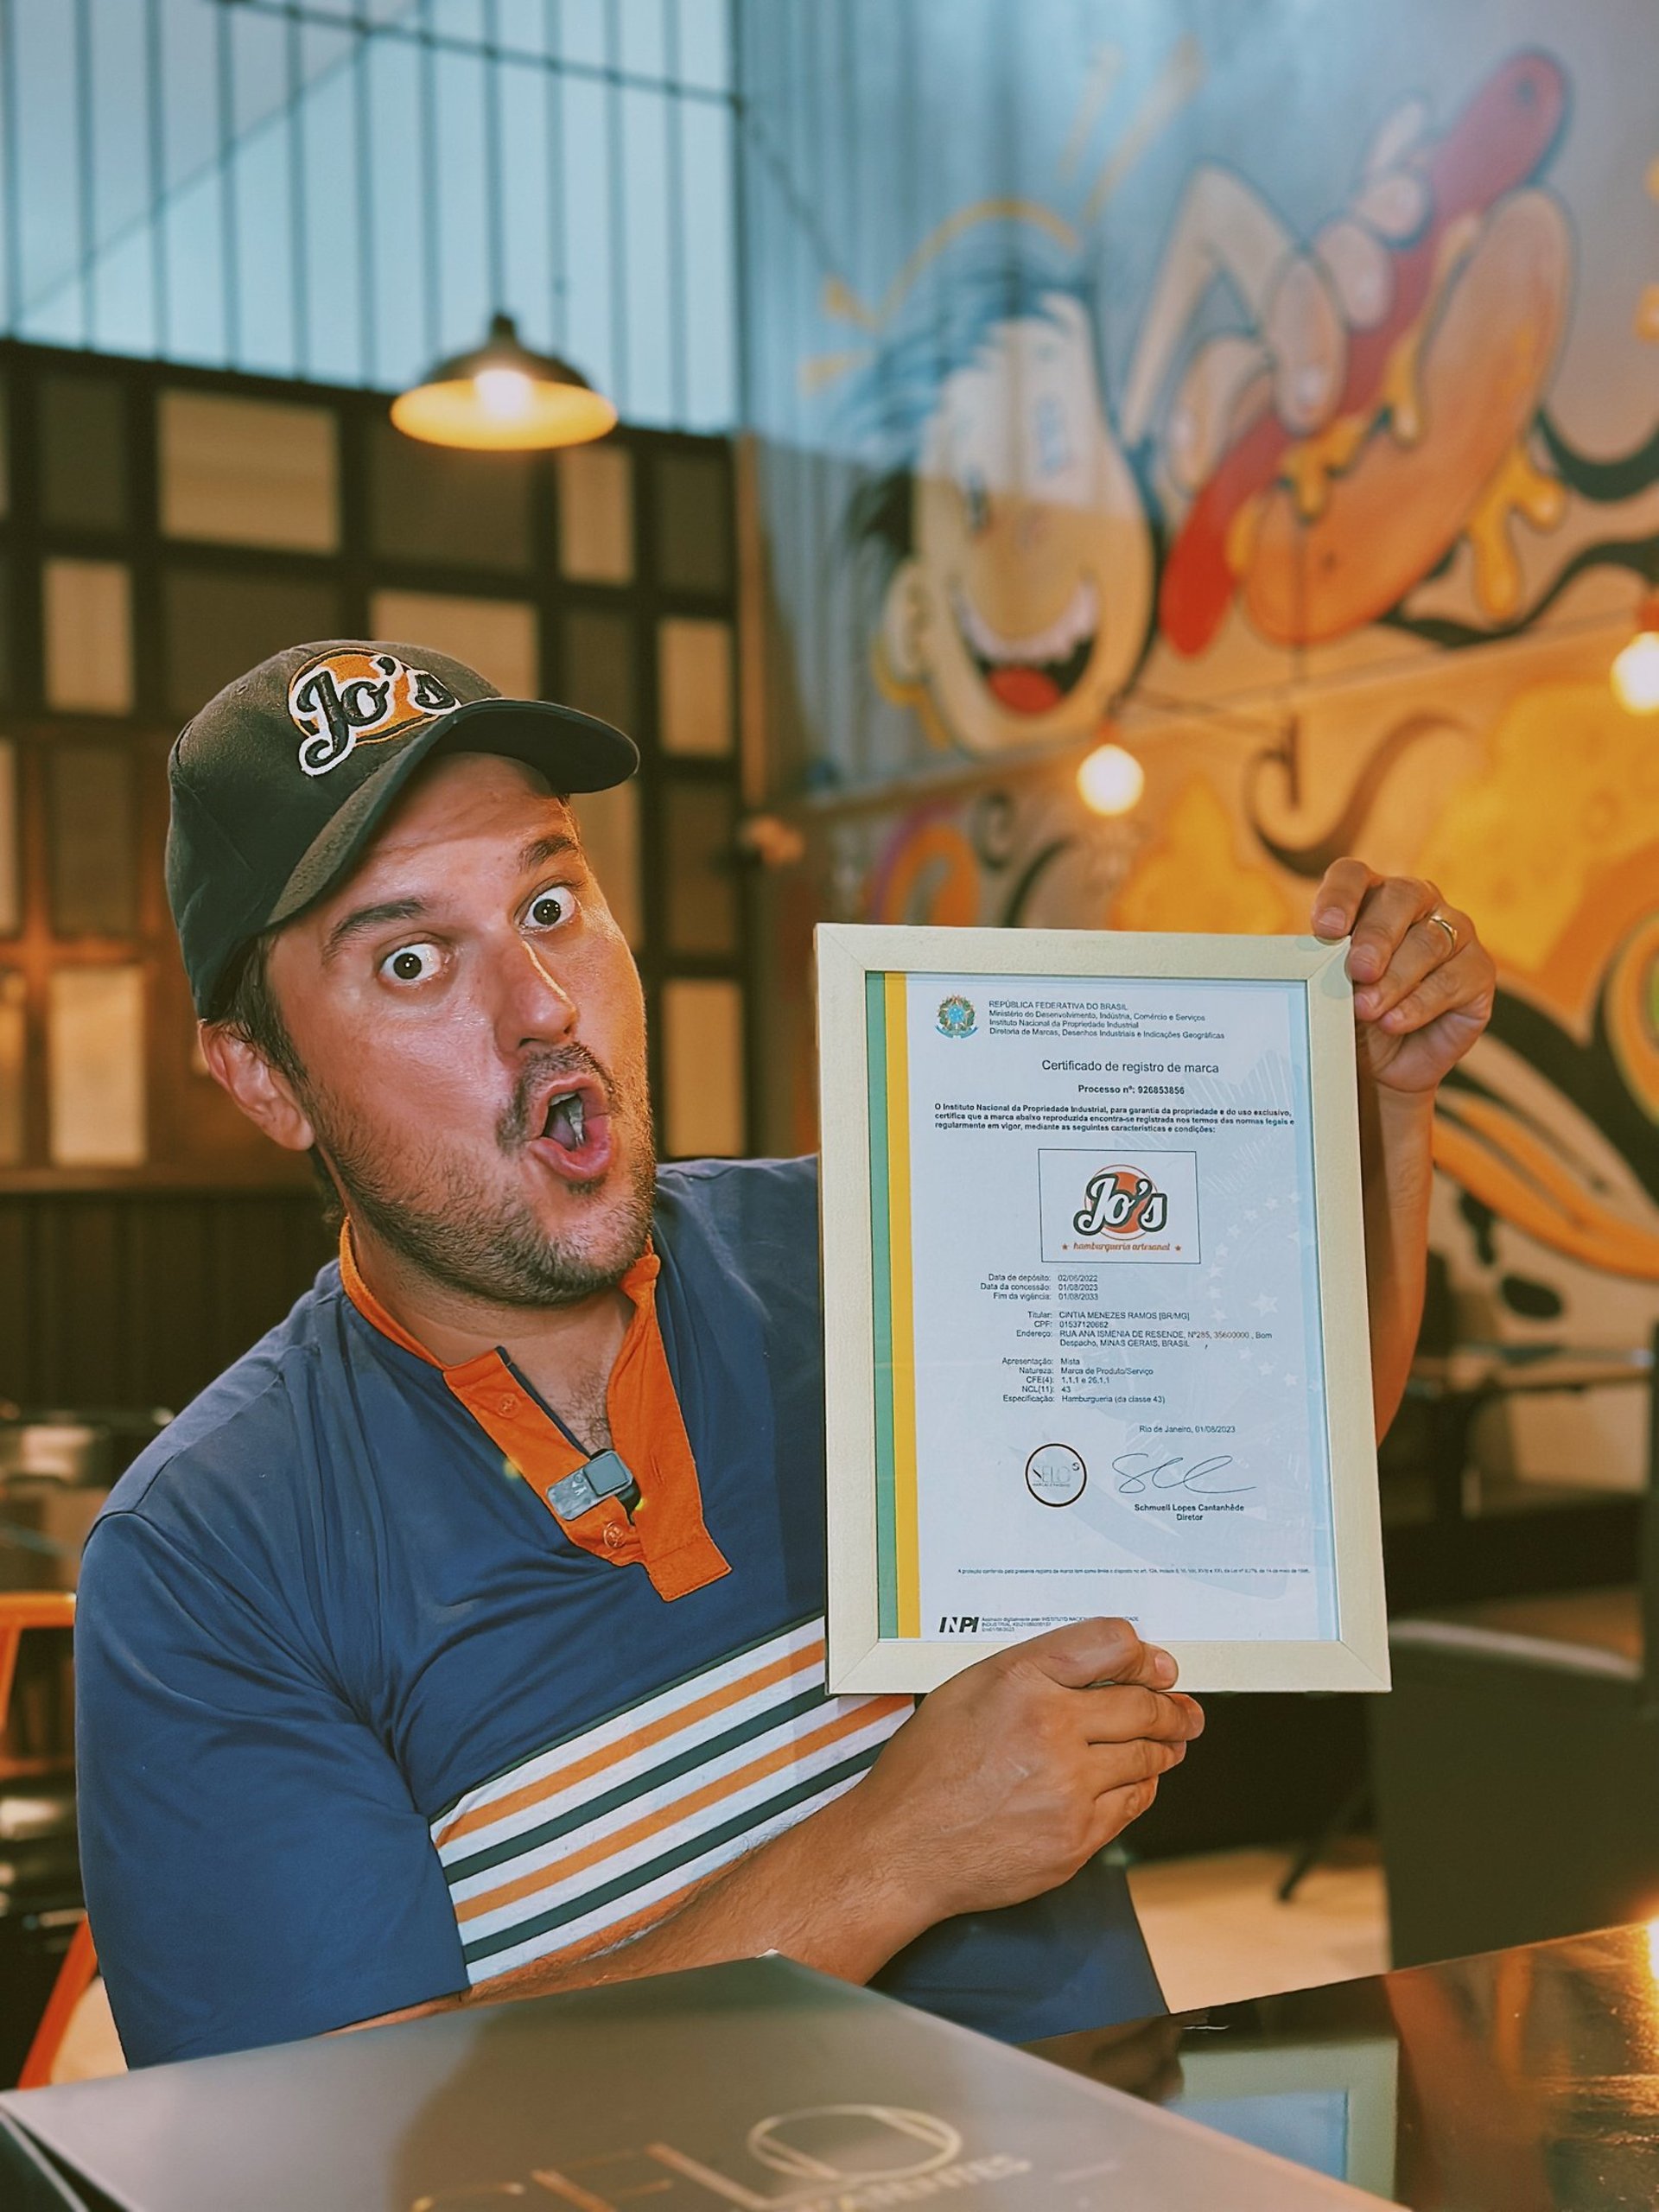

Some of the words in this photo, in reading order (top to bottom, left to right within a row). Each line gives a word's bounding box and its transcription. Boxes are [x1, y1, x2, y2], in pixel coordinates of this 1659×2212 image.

[289, 652, 461, 777] Jo's
[988, 999, 1033, 1008] REPÚBLICA
[1034, 1011, 1098, 1020] Desenvolvimento,
[1099, 1012, 1132, 1020] Indústria,
[1175, 1014, 1206, 1022] Serviços
[1061, 1020, 1106, 1029] Propriedade
[1032, 1028, 1061, 1037] Marcas,
[1143, 1030, 1181, 1039] Indicações
[1182, 1031, 1225, 1040] Geográficas
[1041, 1060, 1103, 1071] Certificado
[1104, 1061, 1120, 1071] de
[1122, 1061, 1165, 1075] registro
[1166, 1062, 1181, 1072] de
[1184, 1065, 1220, 1073] marca
[1077, 1085, 1122, 1094] Processo
[1122, 1085, 1135, 1094] nº:
[1137, 1085, 1185, 1095] 926853856
[1022, 1104, 1069, 1114] Propriedade
[1071, 1105, 1109, 1114] Industrial,
[1128, 1106, 1160, 1116] garantia
[1172, 1107, 1218, 1116] propriedade
[1253, 1109, 1293, 1117] exclusivo,
[1042, 1114, 1089, 1123] reproduzida
[1135, 1116, 1174, 1124] registrada
[1265, 1117, 1288, 1127] legais
[934, 1122, 986, 1131] regularmente
[1001, 1122, 1022, 1131] vigor,
[1071, 1123, 1109, 1133] seguintes
[1173, 1125, 1217, 1134] condições:
[1073, 1173, 1168, 1236] Jo's
[1073, 1243, 1130, 1252] hamburgueria
[1018, 1274, 1051, 1283] depósito:
[1015, 1330, 1052, 1338] Endereço:
[1144, 1331, 1185, 1339] RESENDE,
[1059, 1339, 1098, 1348] Despacho,
[1127, 1339, 1160, 1348] GERAIS,
[1001, 1357, 1053, 1367] Apresentação:
[1002, 1395, 1055, 1404] Especificação:
[1061, 1395, 1113, 1404] Hamburgueria
[1114, 1395, 1127, 1404] (da
[1153, 1395, 1166, 1405] 43)
[1165, 1426, 1193, 1434] Janeiro,
[1172, 1503, 1197, 1513] Lopes
[939, 1617, 979, 1633] INPI
